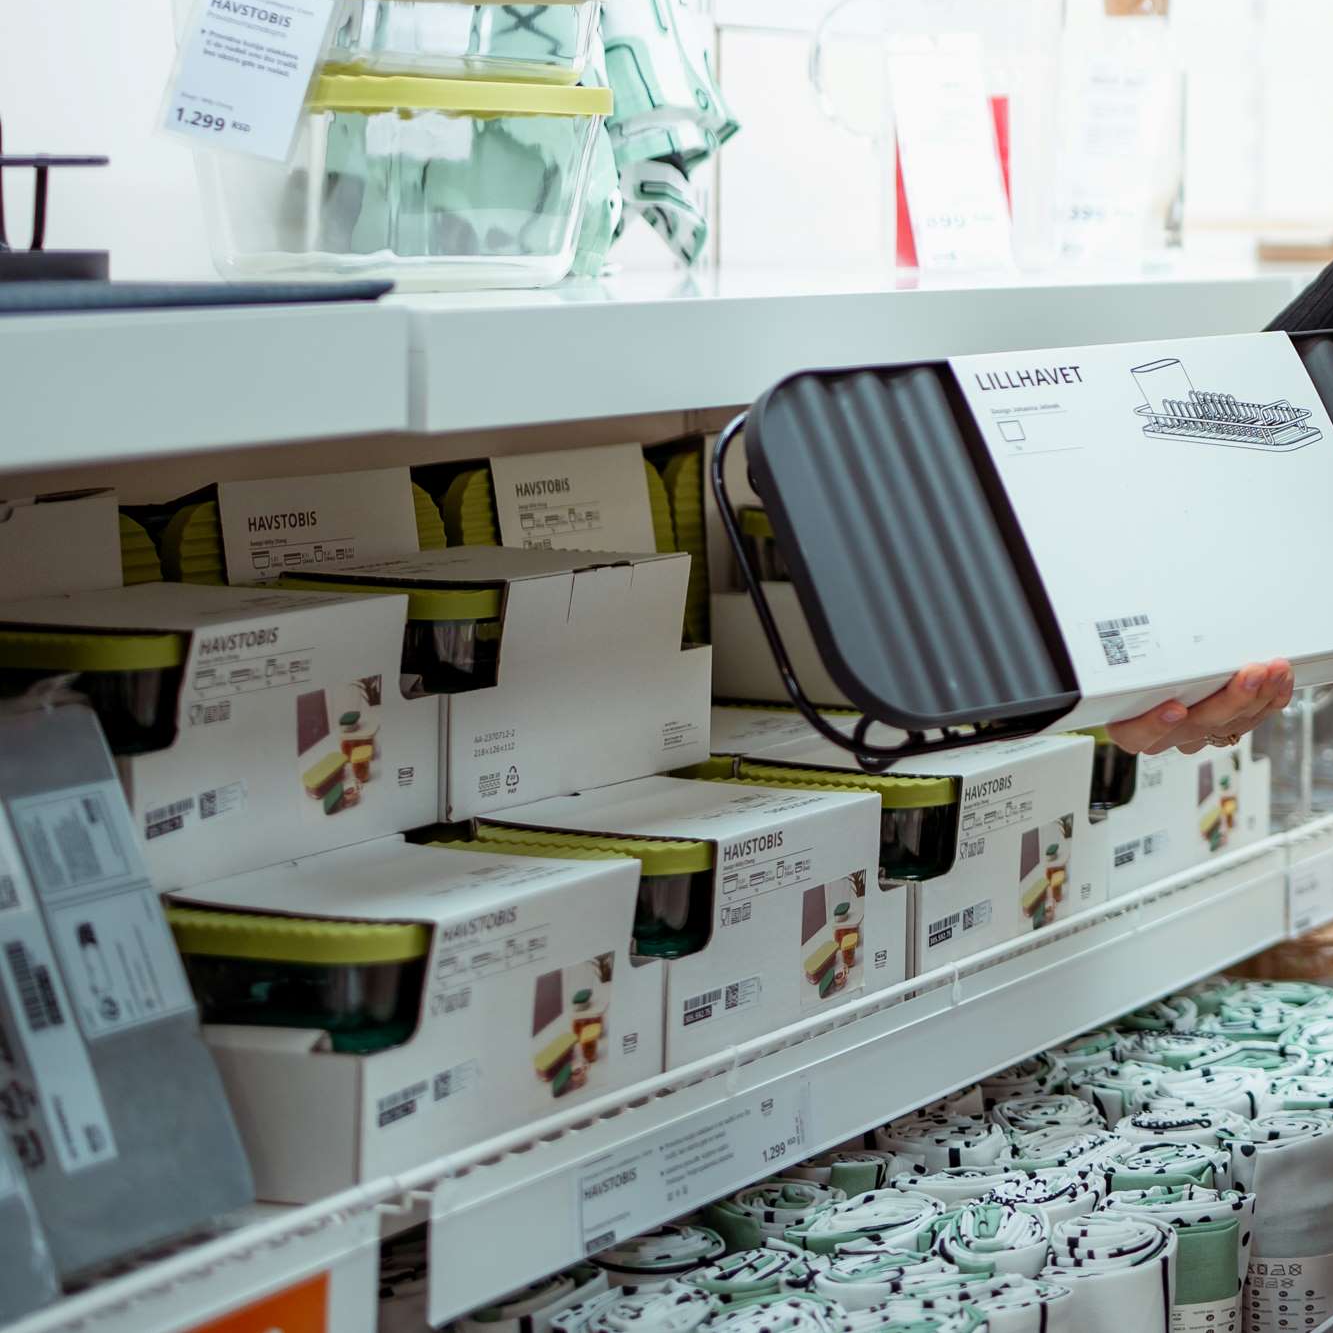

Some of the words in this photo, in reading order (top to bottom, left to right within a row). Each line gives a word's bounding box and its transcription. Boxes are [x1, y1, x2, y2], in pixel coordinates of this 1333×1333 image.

[176, 107, 226, 131] 1.299
[975, 366, 1084, 391] LILLHAVET
[515, 478, 570, 498] HAVSTOBIS
[248, 511, 318, 533] HAVSTOBIS
[199, 627, 279, 656] HAVSTOBIS
[963, 774, 1012, 803] HAVSTOBIS
[723, 831, 784, 862] HAVSTOBIS
[441, 906, 518, 942] HAVSTOBIS
[762, 1142, 786, 1162] 1.299
[584, 1167, 637, 1201] HAVSTOBIS
